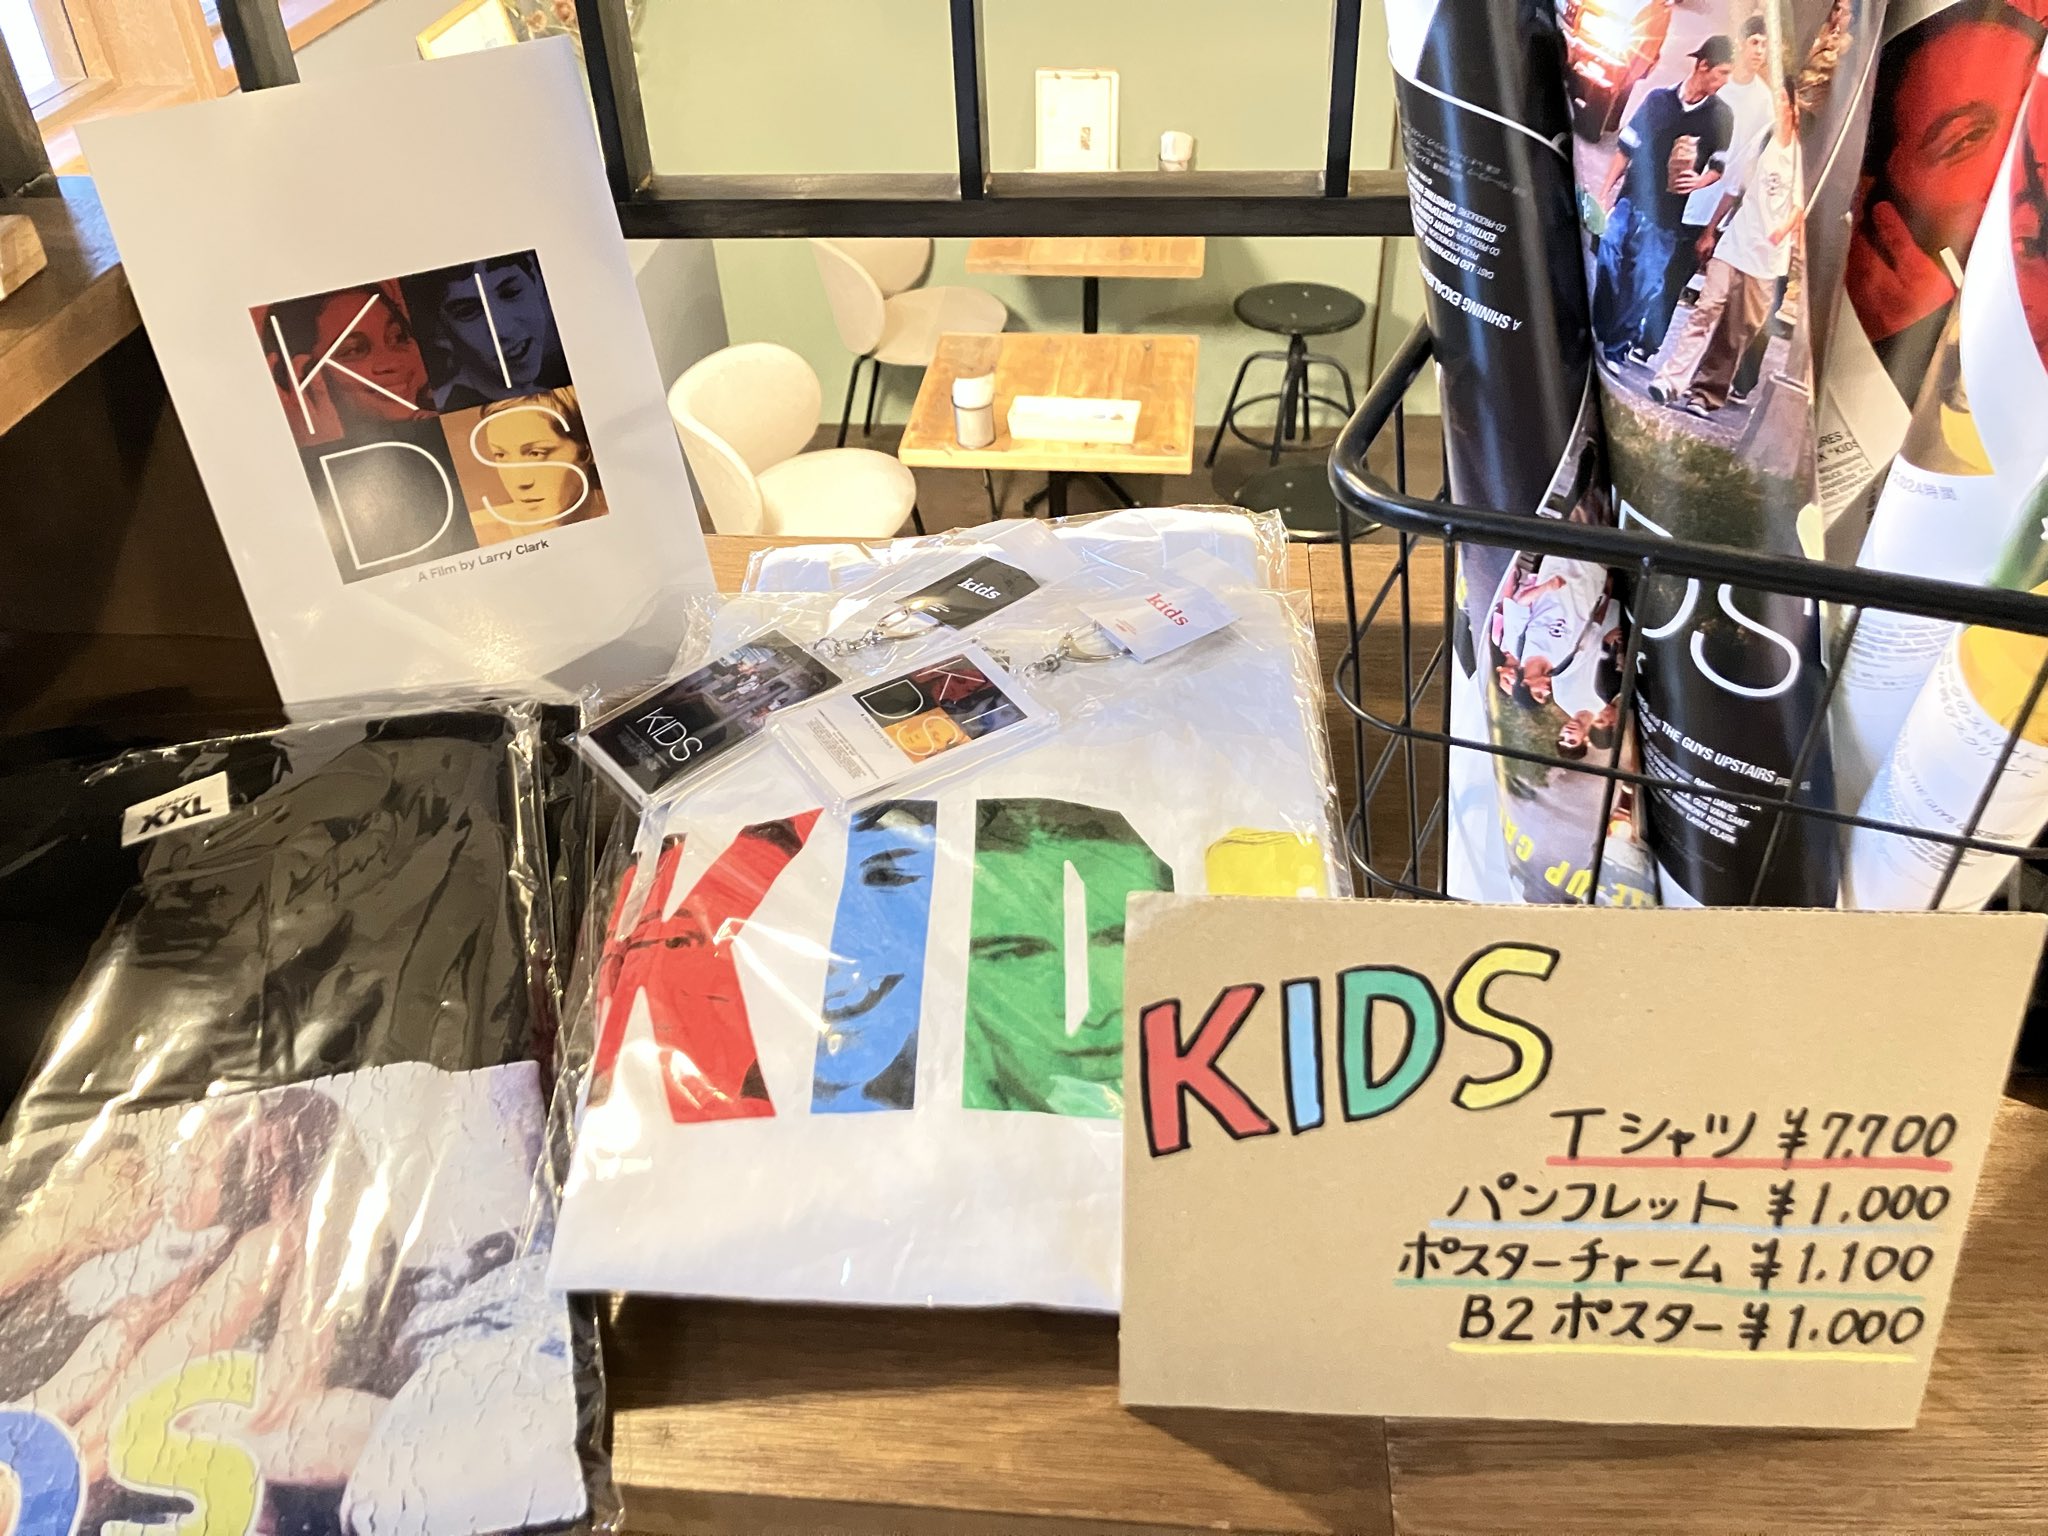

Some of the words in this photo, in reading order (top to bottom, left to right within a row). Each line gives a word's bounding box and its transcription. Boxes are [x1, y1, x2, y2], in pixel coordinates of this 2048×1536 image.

[1460, 259, 1476, 273] LEO
[1461, 297, 1512, 329] SHINING
[1512, 319, 1523, 331] A
[418, 571, 429, 582] A
[430, 564, 457, 579] Film
[459, 559, 475, 573] by
[478, 549, 512, 566] Larry
[515, 539, 550, 556] Clark
[957, 577, 1001, 600] kids
[1145, 592, 1190, 627] kids
[636, 704, 704, 763] KIDS
[1661, 720, 1682, 743] THE
[1681, 736, 1714, 761] GUYS
[1714, 752, 1777, 787] UPSTAIRS
[138, 795, 212, 835] XXL
[588, 797, 1325, 1123] KID
[1139, 941, 1561, 1158] KIDS
[1447, 1172, 1738, 1224] パンフレット
[1399, 1231, 1722, 1284] ポスターチャーム
